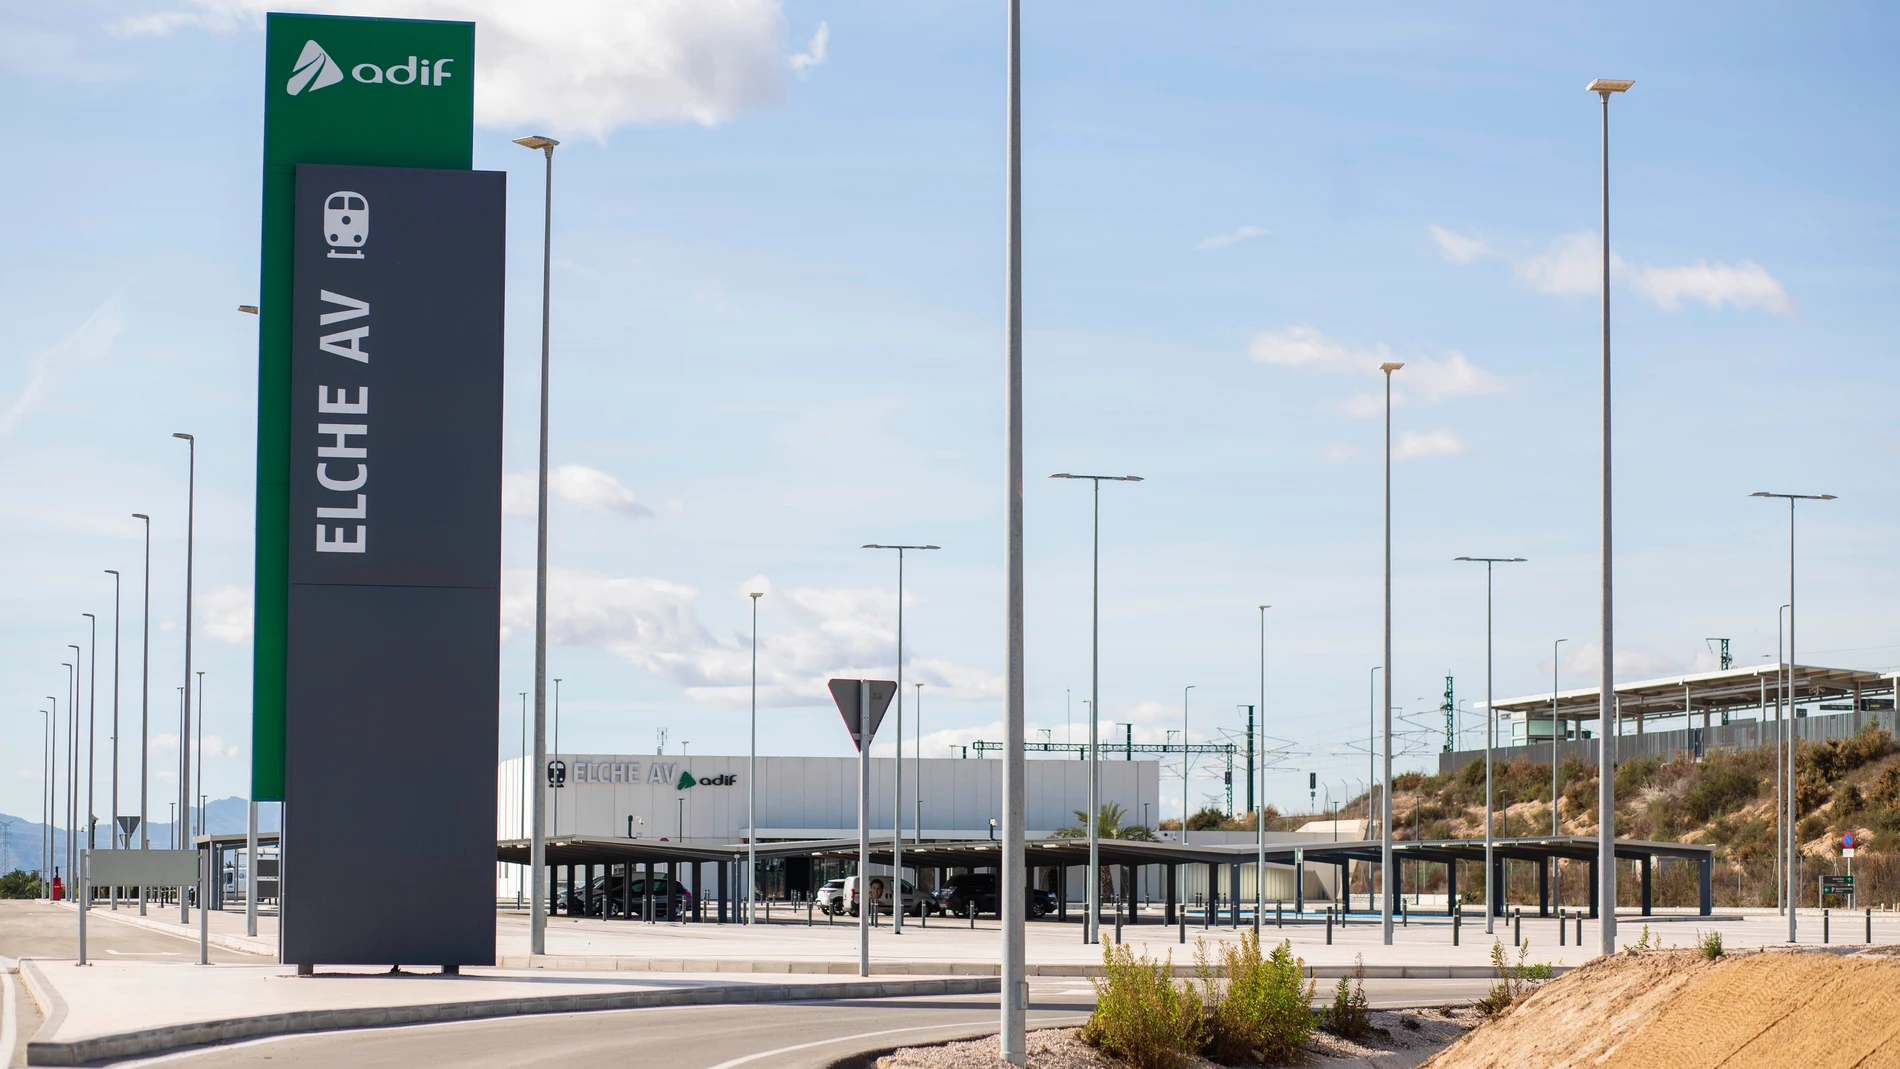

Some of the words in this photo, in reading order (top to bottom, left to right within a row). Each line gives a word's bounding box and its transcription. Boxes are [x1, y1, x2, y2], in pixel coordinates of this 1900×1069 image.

[352, 56, 454, 86] adif
[319, 290, 370, 364] AV
[317, 385, 369, 553] ELCHE
[573, 762, 640, 784] ELCHE
[648, 762, 677, 784] AV
[699, 774, 737, 786] adif
